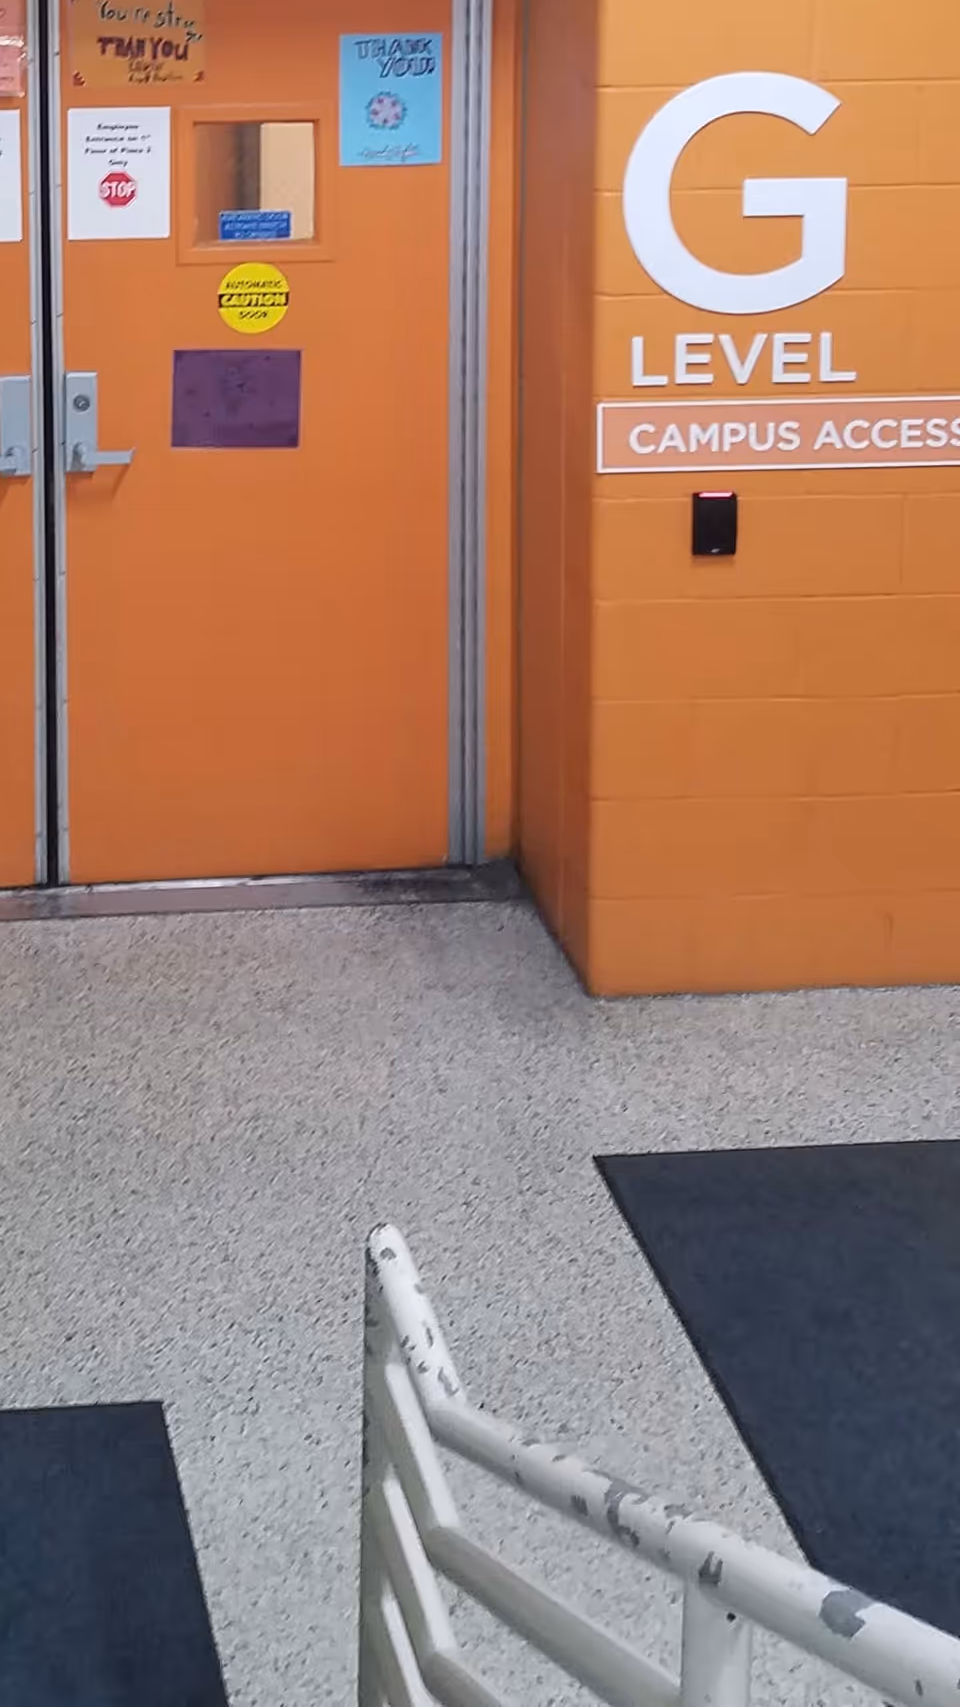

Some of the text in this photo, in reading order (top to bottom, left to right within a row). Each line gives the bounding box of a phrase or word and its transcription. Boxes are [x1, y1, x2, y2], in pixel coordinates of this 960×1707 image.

[100, 180, 136, 198] STOP
[623, 71, 848, 315] G
[225, 279, 283, 290] AUTOMATIC
[220, 293, 286, 307] CAUTION
[631, 332, 857, 387] LEVEL
[628, 421, 800, 455] CAMPUS
